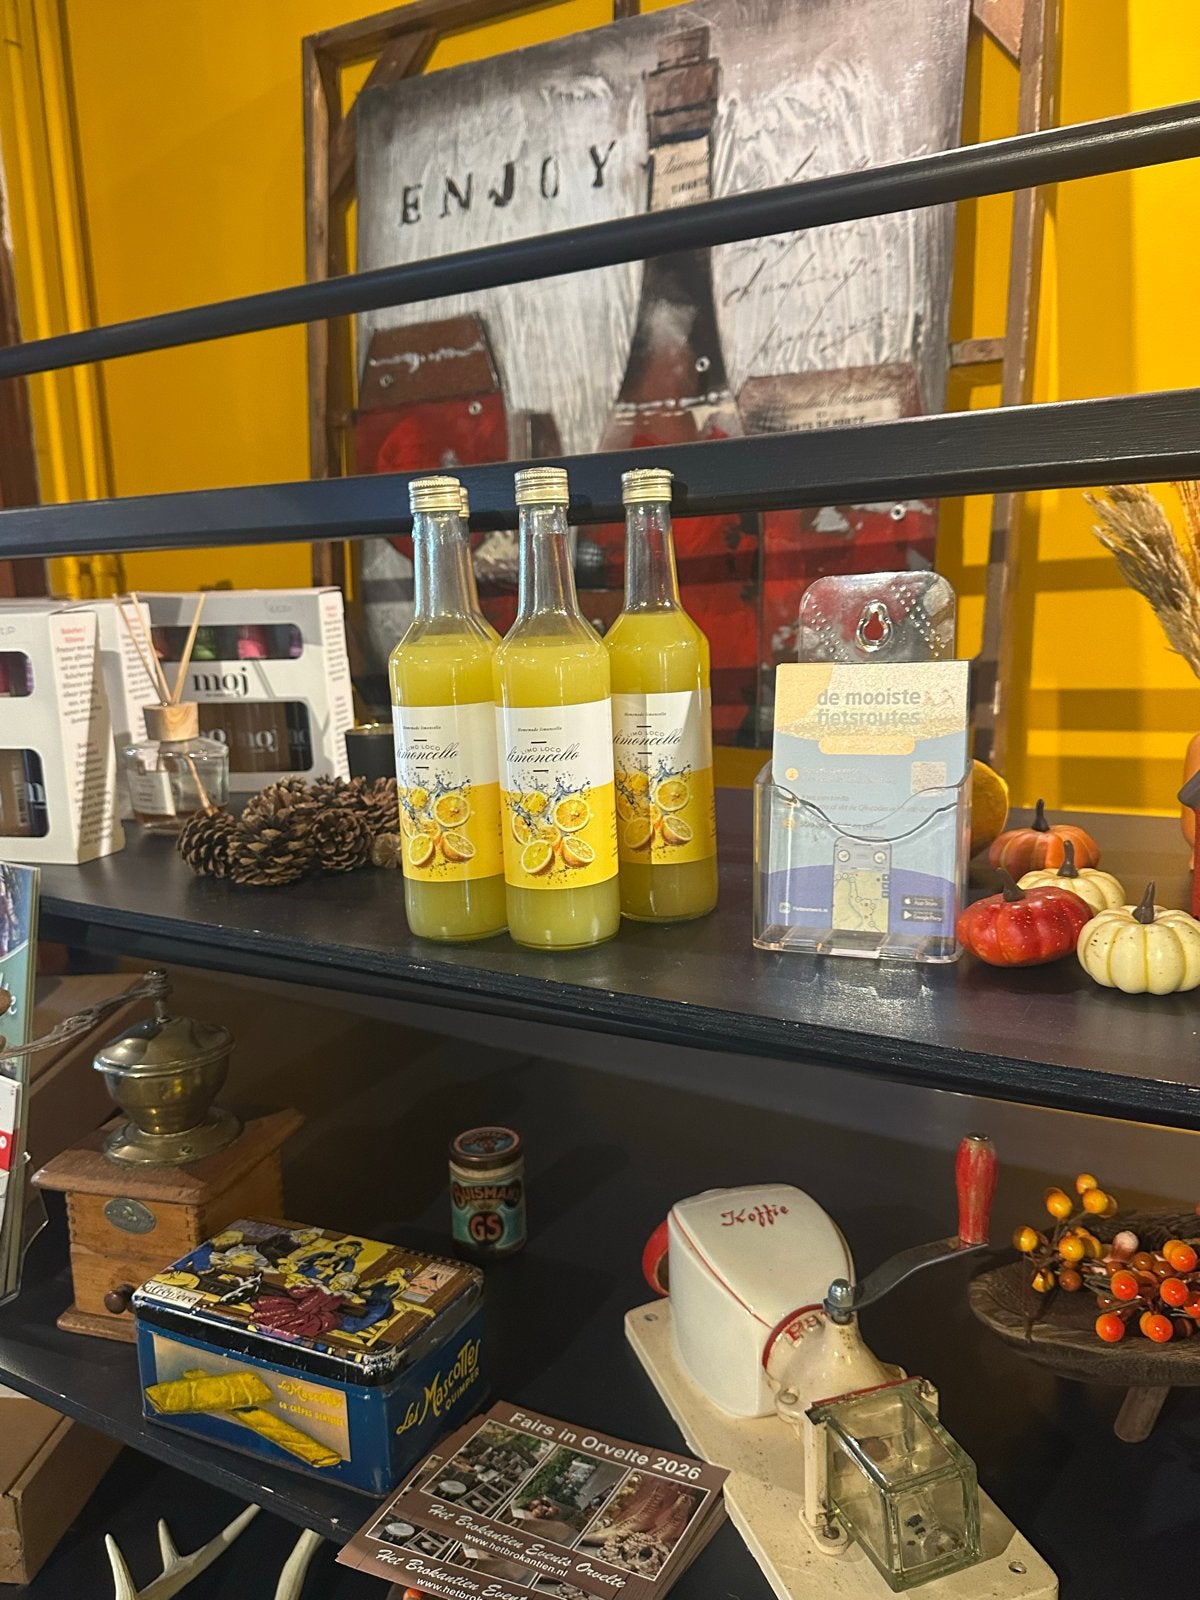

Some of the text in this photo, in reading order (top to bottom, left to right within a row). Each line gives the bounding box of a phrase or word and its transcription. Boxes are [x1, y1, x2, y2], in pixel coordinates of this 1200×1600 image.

[400, 140, 615, 225] ENJOY
[192, 667, 249, 695] moj
[817, 688, 921, 705] de mooiste
[816, 708, 921, 726] fietsroutes
[613, 727, 682, 745] limoncello
[507, 742, 580, 762] limoncello
[521, 746, 538, 754] LIMO
[471, 1215, 501, 1241] GS
[721, 1204, 789, 1227] Koffie
[396, 1338, 481, 1435] Les Mascottes
[509, 1412, 702, 1481] Fairs in Orvelte 2026
[428, 1504, 627, 1588] Het Brokantien Events Orvelte
[464, 1533, 569, 1578] www.hetbrokantien.nl
[376, 1549, 405, 1566] Het
[405, 1558, 480, 1591] Brokantien
